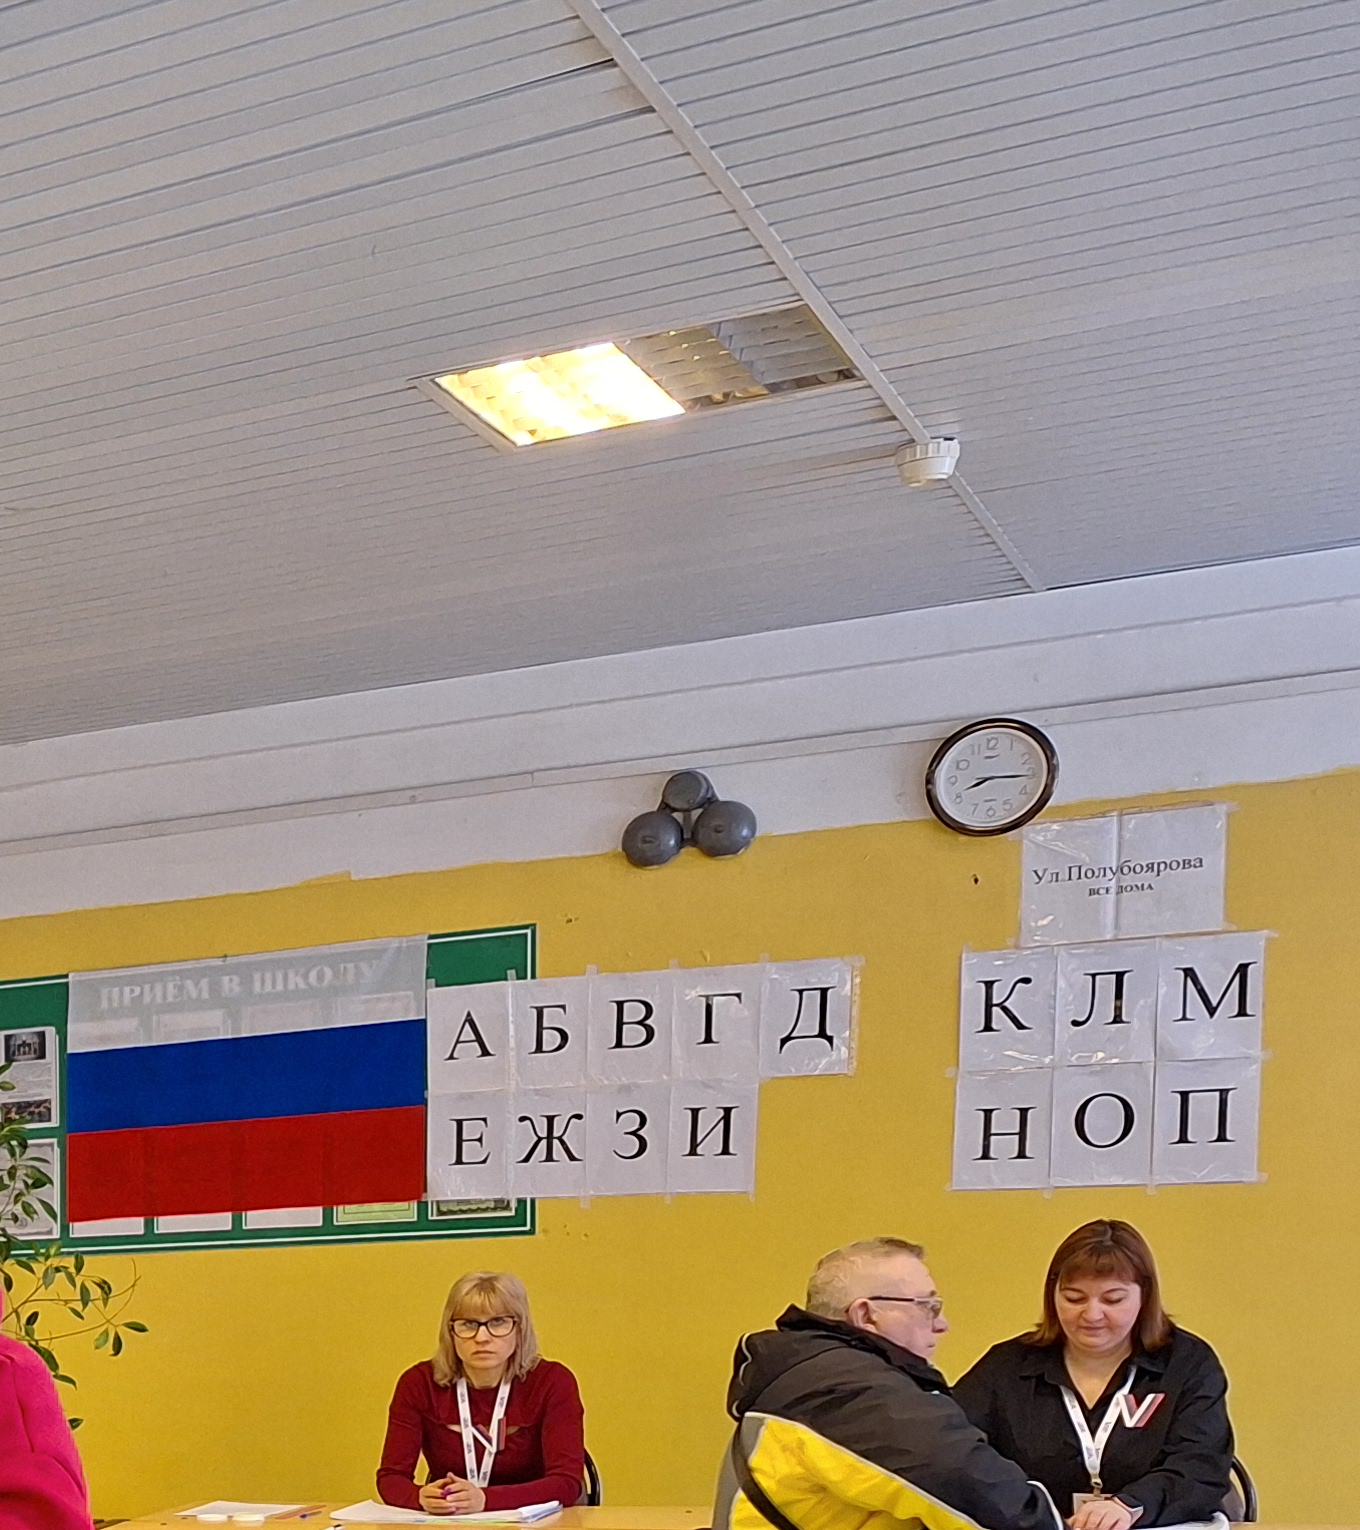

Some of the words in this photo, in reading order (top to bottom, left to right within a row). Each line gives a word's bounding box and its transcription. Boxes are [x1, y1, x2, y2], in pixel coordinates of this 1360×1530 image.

[970, 742, 982, 755] 11
[986, 737, 999, 750] 12
[1009, 738, 1014, 751] 1
[1021, 752, 1031, 765] 2
[947, 775, 958, 786] 9
[1019, 784, 1028, 795] 4
[971, 803, 979, 815] 7
[1002, 799, 1013, 811] 5
[985, 806, 996, 818] 6
[1088, 885, 1113, 897] ВСЕ
[1115, 882, 1154, 895] ДОМА
[99, 978, 209, 1009] ПРИЁМ
[221, 975, 241, 997] В
[253, 959, 378, 995] ШКОЛУ
[974, 976, 1033, 1033] К
[1070, 969, 1134, 1028] Л
[1172, 961, 1258, 1022] М
[443, 1009, 496, 1061] А
[528, 1004, 569, 1055] Б
[608, 998, 656, 1050] В
[696, 992, 742, 1045] Г
[779, 985, 837, 1054] Д
[972, 1106, 1037, 1161] Н
[1074, 1092, 1135, 1149] О
[1168, 1087, 1238, 1145] П
[448, 1116, 491, 1166] Е
[516, 1113, 584, 1164] Ж
[613, 1108, 648, 1160] З
[681, 1105, 740, 1157] И
